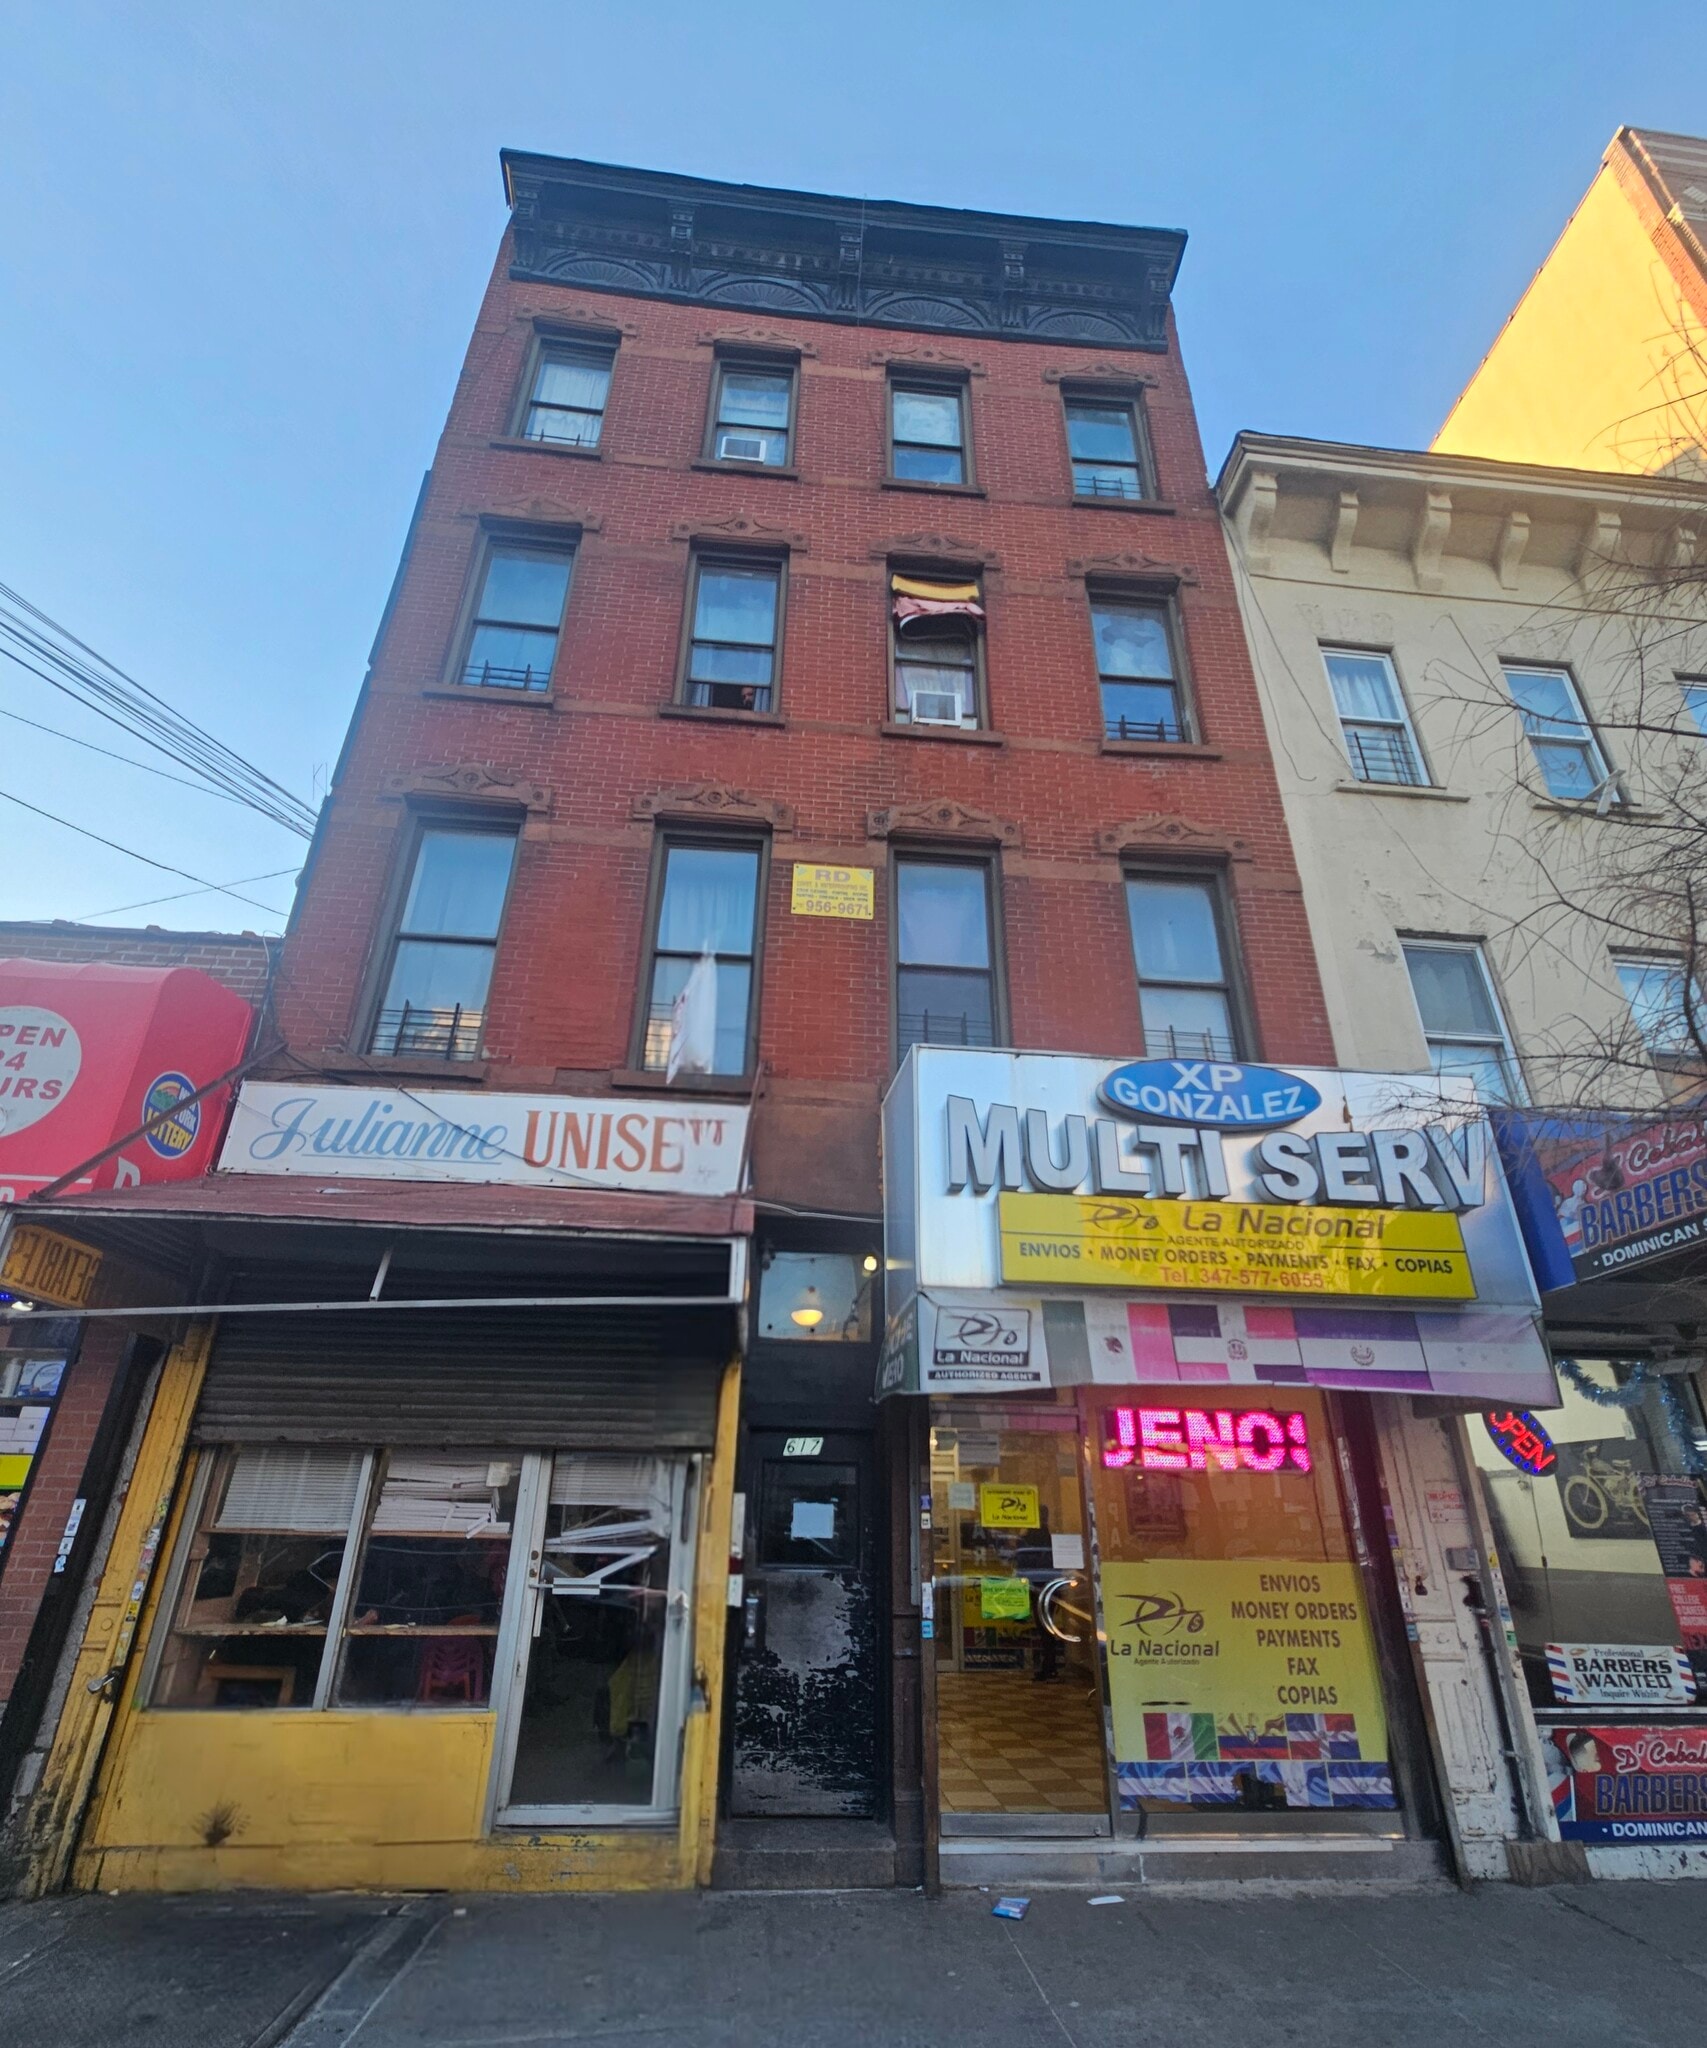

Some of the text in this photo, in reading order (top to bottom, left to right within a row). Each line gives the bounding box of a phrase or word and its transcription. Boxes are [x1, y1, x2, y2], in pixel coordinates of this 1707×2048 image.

[814, 869, 851, 882] RD
[806, 901, 869, 916] 956-9671
[1170, 1062, 1243, 1092] XP
[1113, 1077, 1305, 1121] GONZALEZ
[249, 1098, 508, 1161] Julianne
[946, 1094, 1486, 1206] MULTI SERV
[1183, 1205, 1385, 1240] La Nacional
[1166, 1235, 1304, 1250] AGENTE AUTORIZADO
[1602, 1223, 1700, 1267] DOMINICAN
[1019, 1242, 1453, 1274] ENVIOS MONEY ORDERS PAYMENTS FAX COPIAS
[1160, 1265, 1324, 1288] Tel. 347-577-6055
[936, 1351, 1024, 1365] La Nacional
[934, 1370, 1034, 1381] AUTHORIZED AGENT
[786, 1438, 821, 1454] 617
[1259, 1574, 1321, 1593] ENVIOS
[1231, 1602, 1358, 1621] MONEY ORDERS
[1256, 1629, 1341, 1648] PAYMENTS
[1110, 1640, 1219, 1657] La Nacional
[1593, 1648, 1645, 1658] Professional
[1287, 1657, 1320, 1676] FAX
[1573, 1658, 1673, 1674] BARBERS
[1582, 1673, 1673, 1689] WANTED
[1277, 1686, 1338, 1705] COPIAS
[1600, 1688, 1660, 1699] Inquire Within
